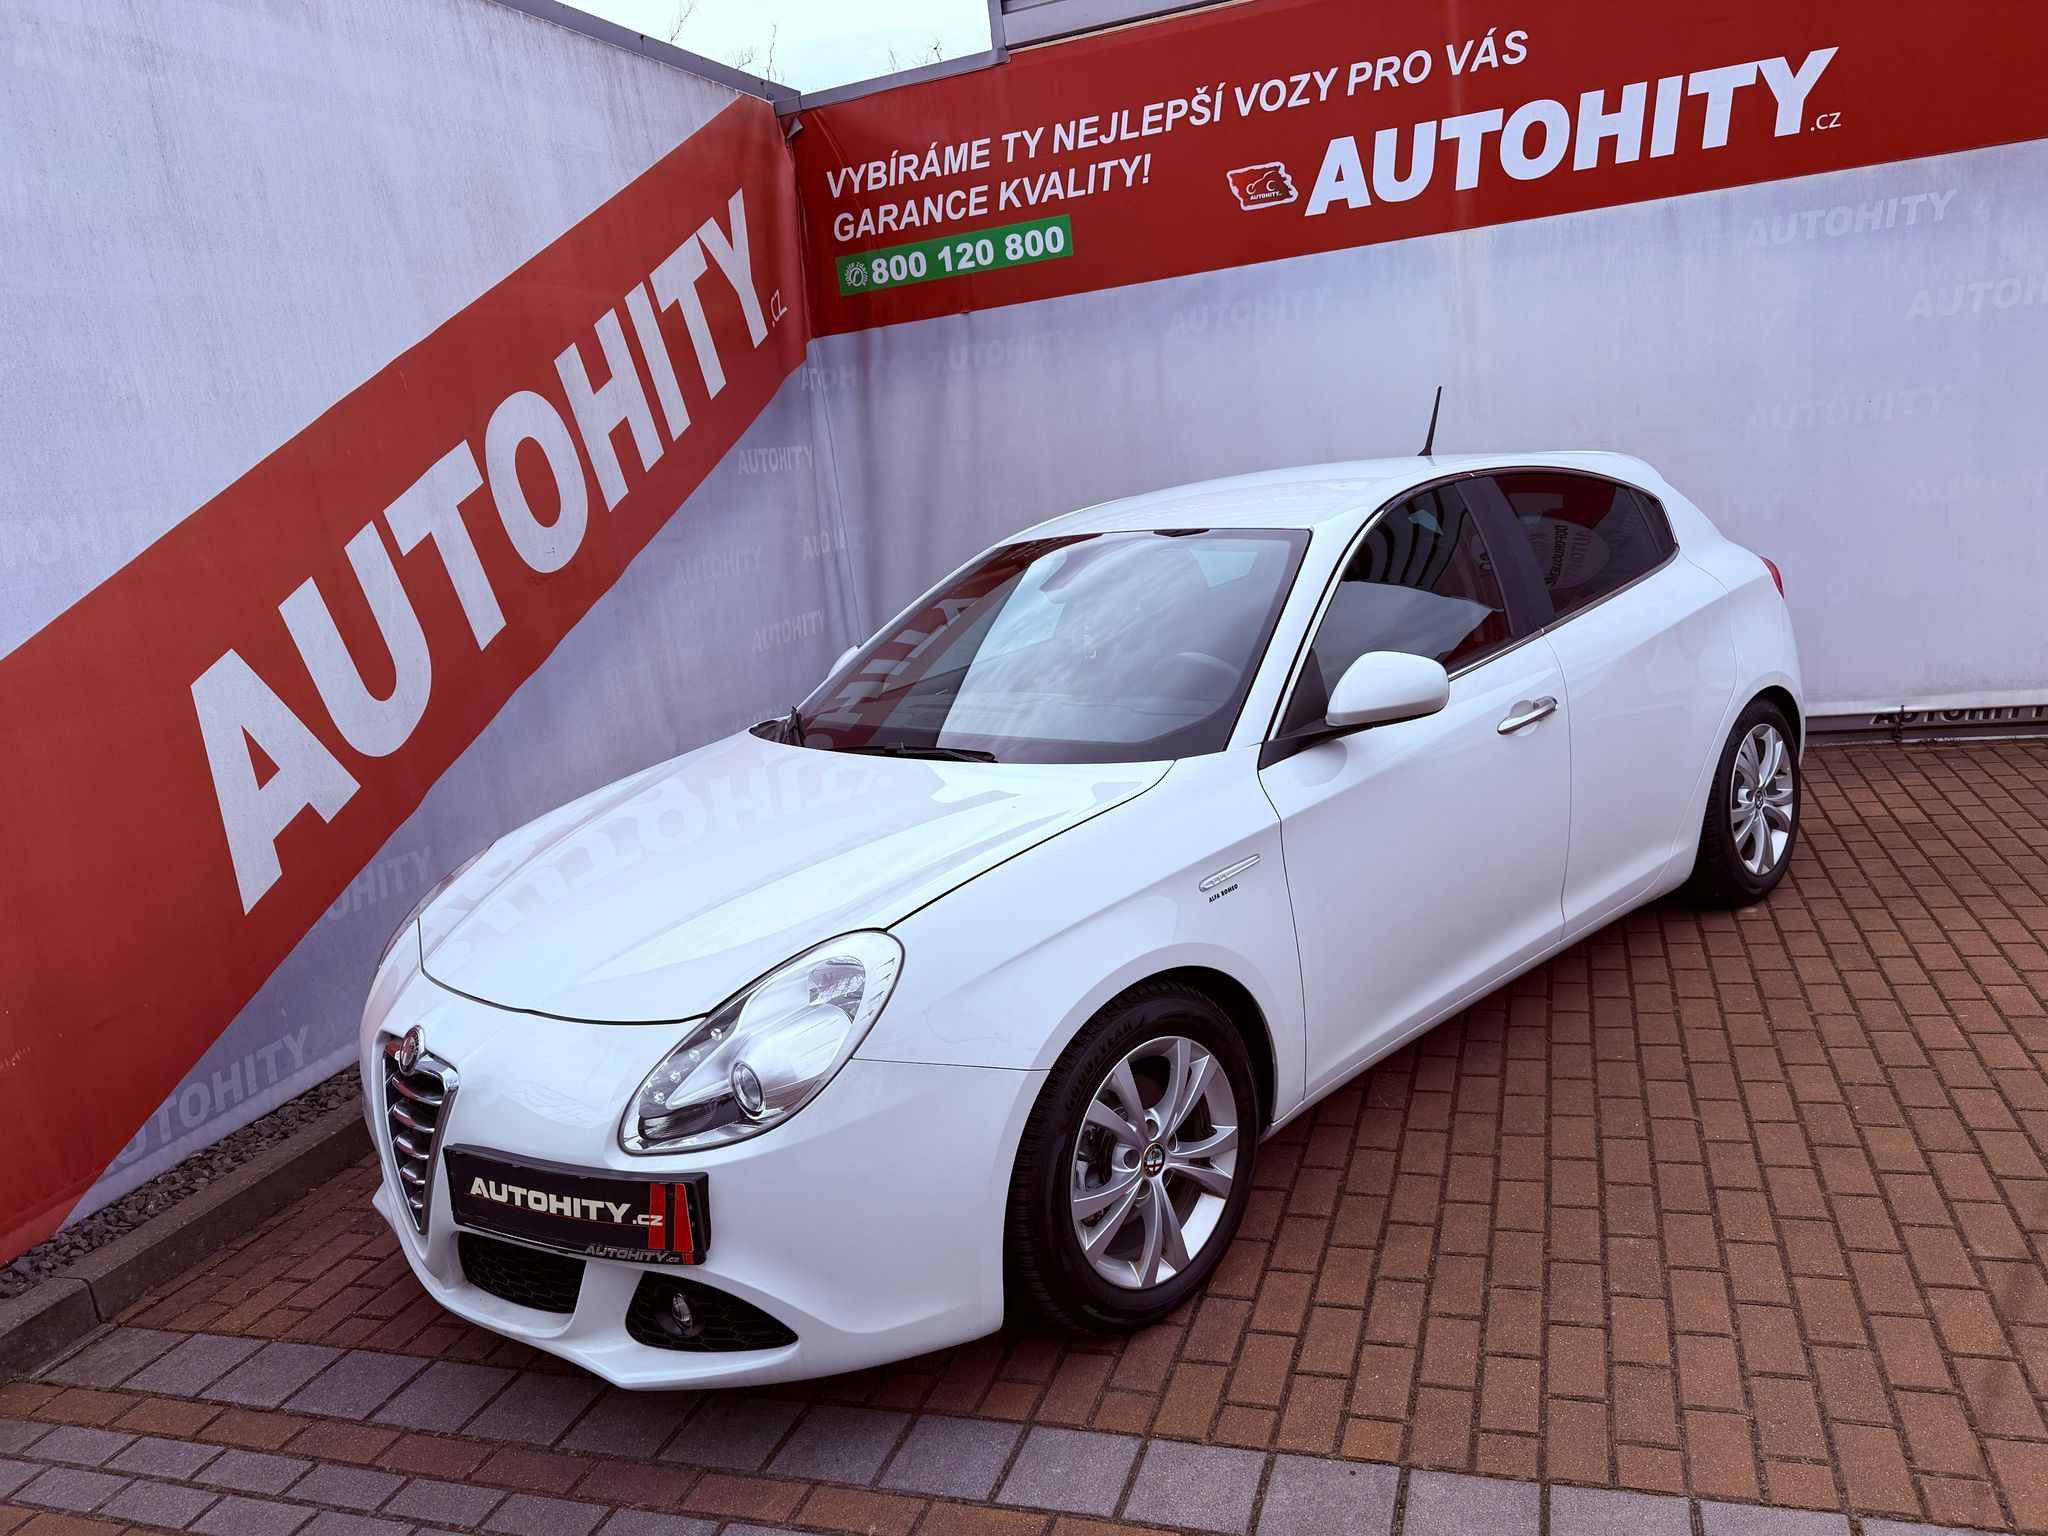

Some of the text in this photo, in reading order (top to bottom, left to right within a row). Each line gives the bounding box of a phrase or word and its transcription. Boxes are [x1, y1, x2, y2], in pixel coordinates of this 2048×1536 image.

[827, 27, 1529, 199] VYBÍRÁME TY NEJLEPŠÍ VOZY PRO VÁS
[833, 153, 1151, 242] GARANCE KVALITY!
[871, 226, 1065, 286] 800 120 800
[1208, 883, 1239, 903] ALFA ROMEO
